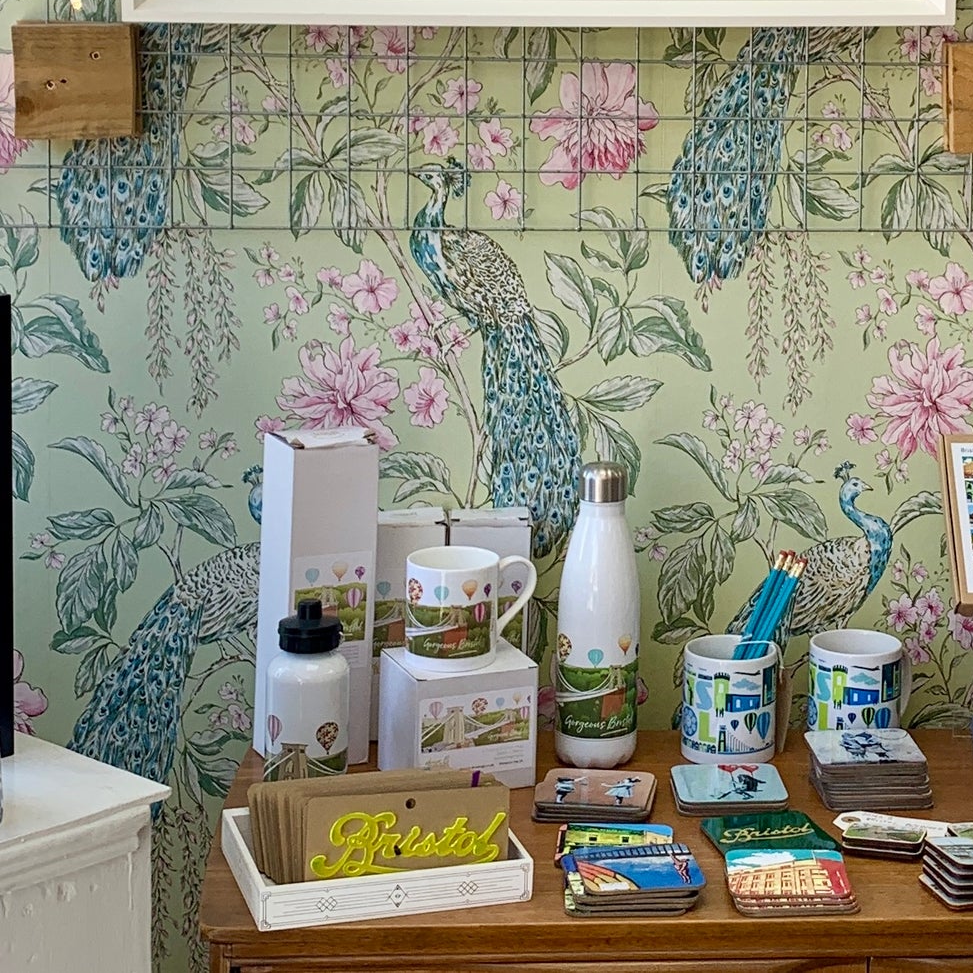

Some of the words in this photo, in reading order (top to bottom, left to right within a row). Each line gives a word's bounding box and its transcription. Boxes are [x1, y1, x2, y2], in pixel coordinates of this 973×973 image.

[423, 638, 456, 654] Gorgeous
[564, 714, 606, 733] Gorgeous
[719, 823, 815, 843] Bristol
[310, 811, 507, 877] Bristol
